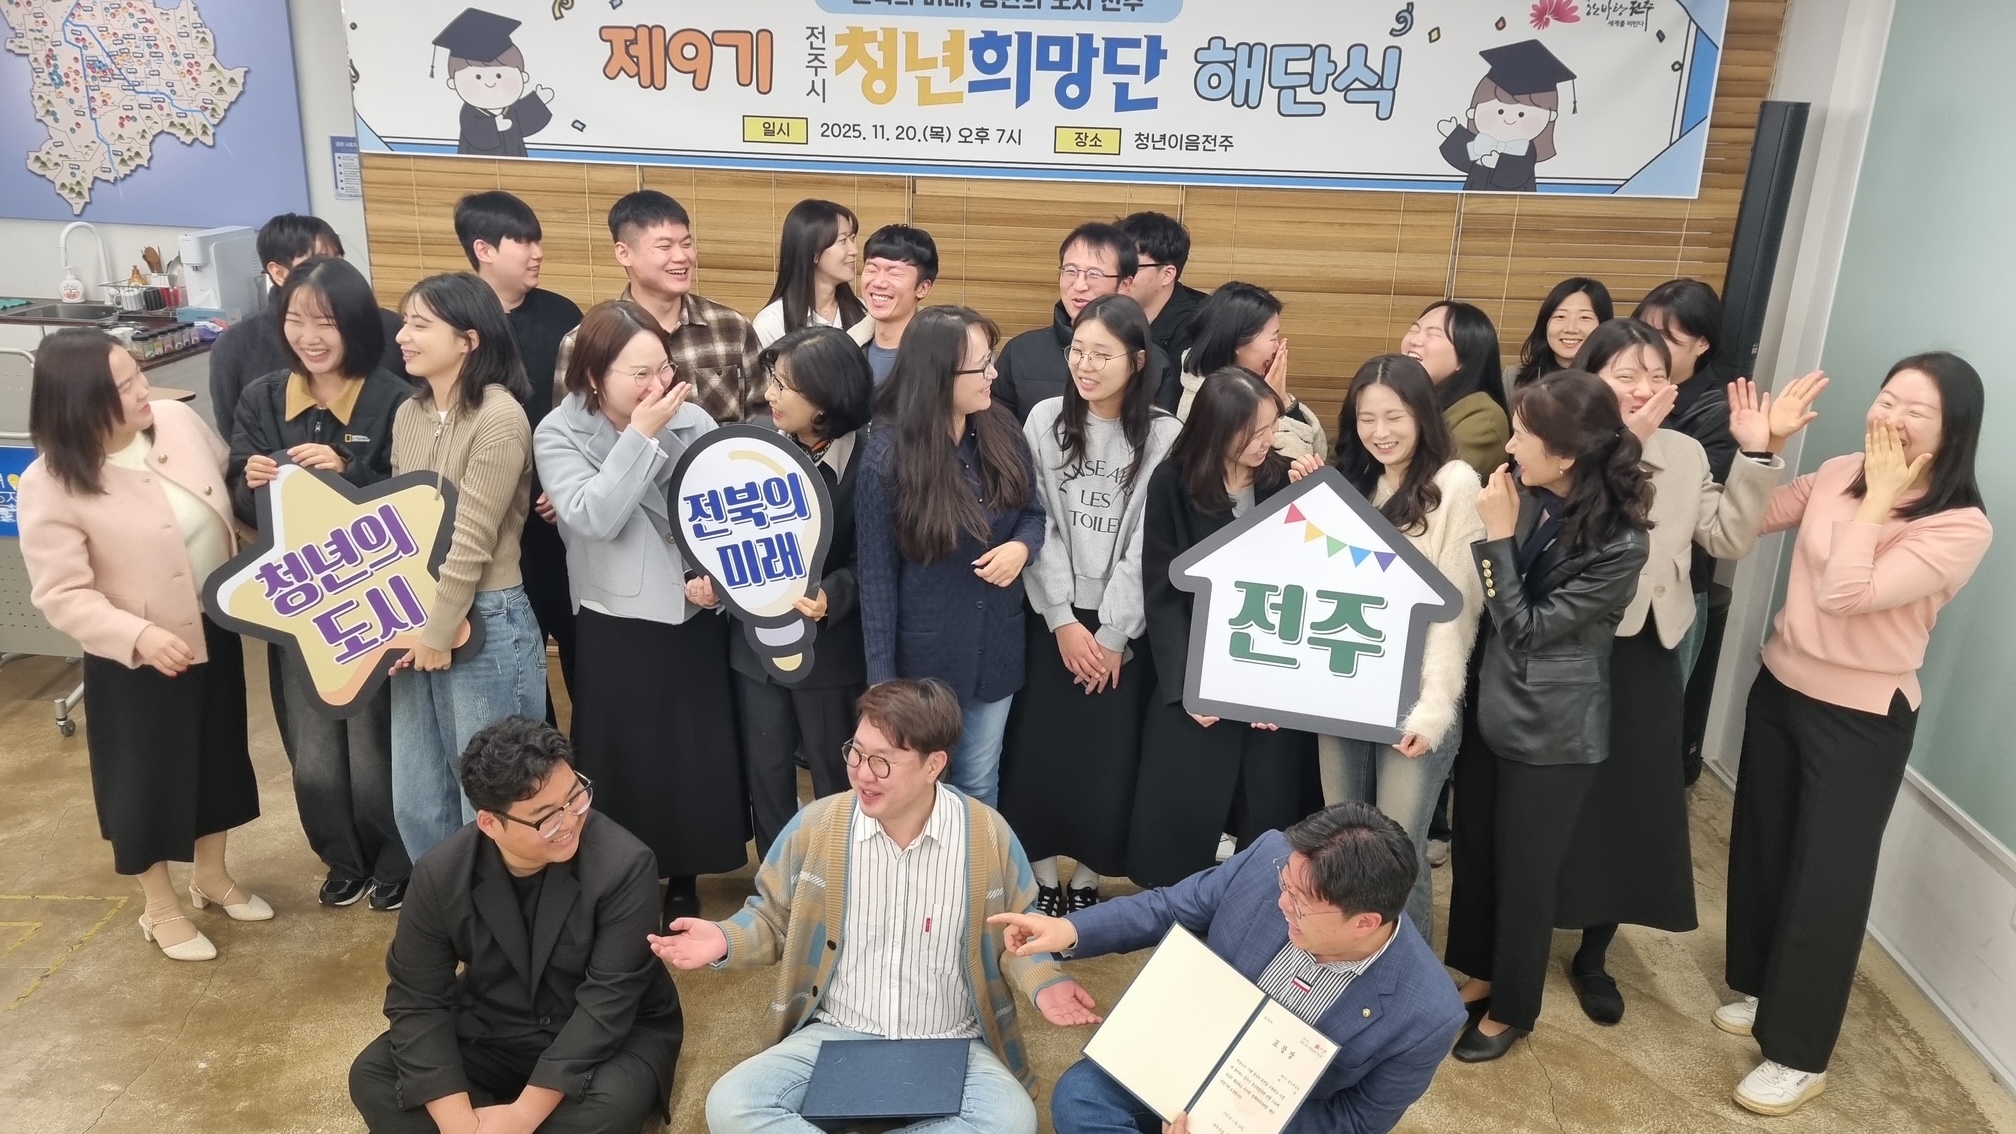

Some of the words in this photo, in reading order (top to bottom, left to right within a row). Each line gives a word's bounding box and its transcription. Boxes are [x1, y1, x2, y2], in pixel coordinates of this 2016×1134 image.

[599, 24, 774, 95] 제9기
[805, 26, 827, 103] 전주시
[835, 26, 1168, 112] 청년희망단
[1194, 36, 1402, 121] 해단식
[762, 121, 791, 138] 일시
[820, 122, 867, 141] 2025.
[871, 124, 891, 142] 11.
[895, 124, 952, 143] 20.(목)
[957, 126, 990, 144] 오후
[995, 128, 1022, 146] 7시
[1074, 131, 1103, 148] 장소
[1134, 131, 1234, 152] 청년이음전주
[683, 472, 812, 541] 전북의
[1080, 489, 1111, 509] LES
[255, 503, 420, 617] 청년의
[716, 531, 807, 590] 미래
[312, 574, 428, 666] 도시
[1228, 580, 1388, 678] 전주
